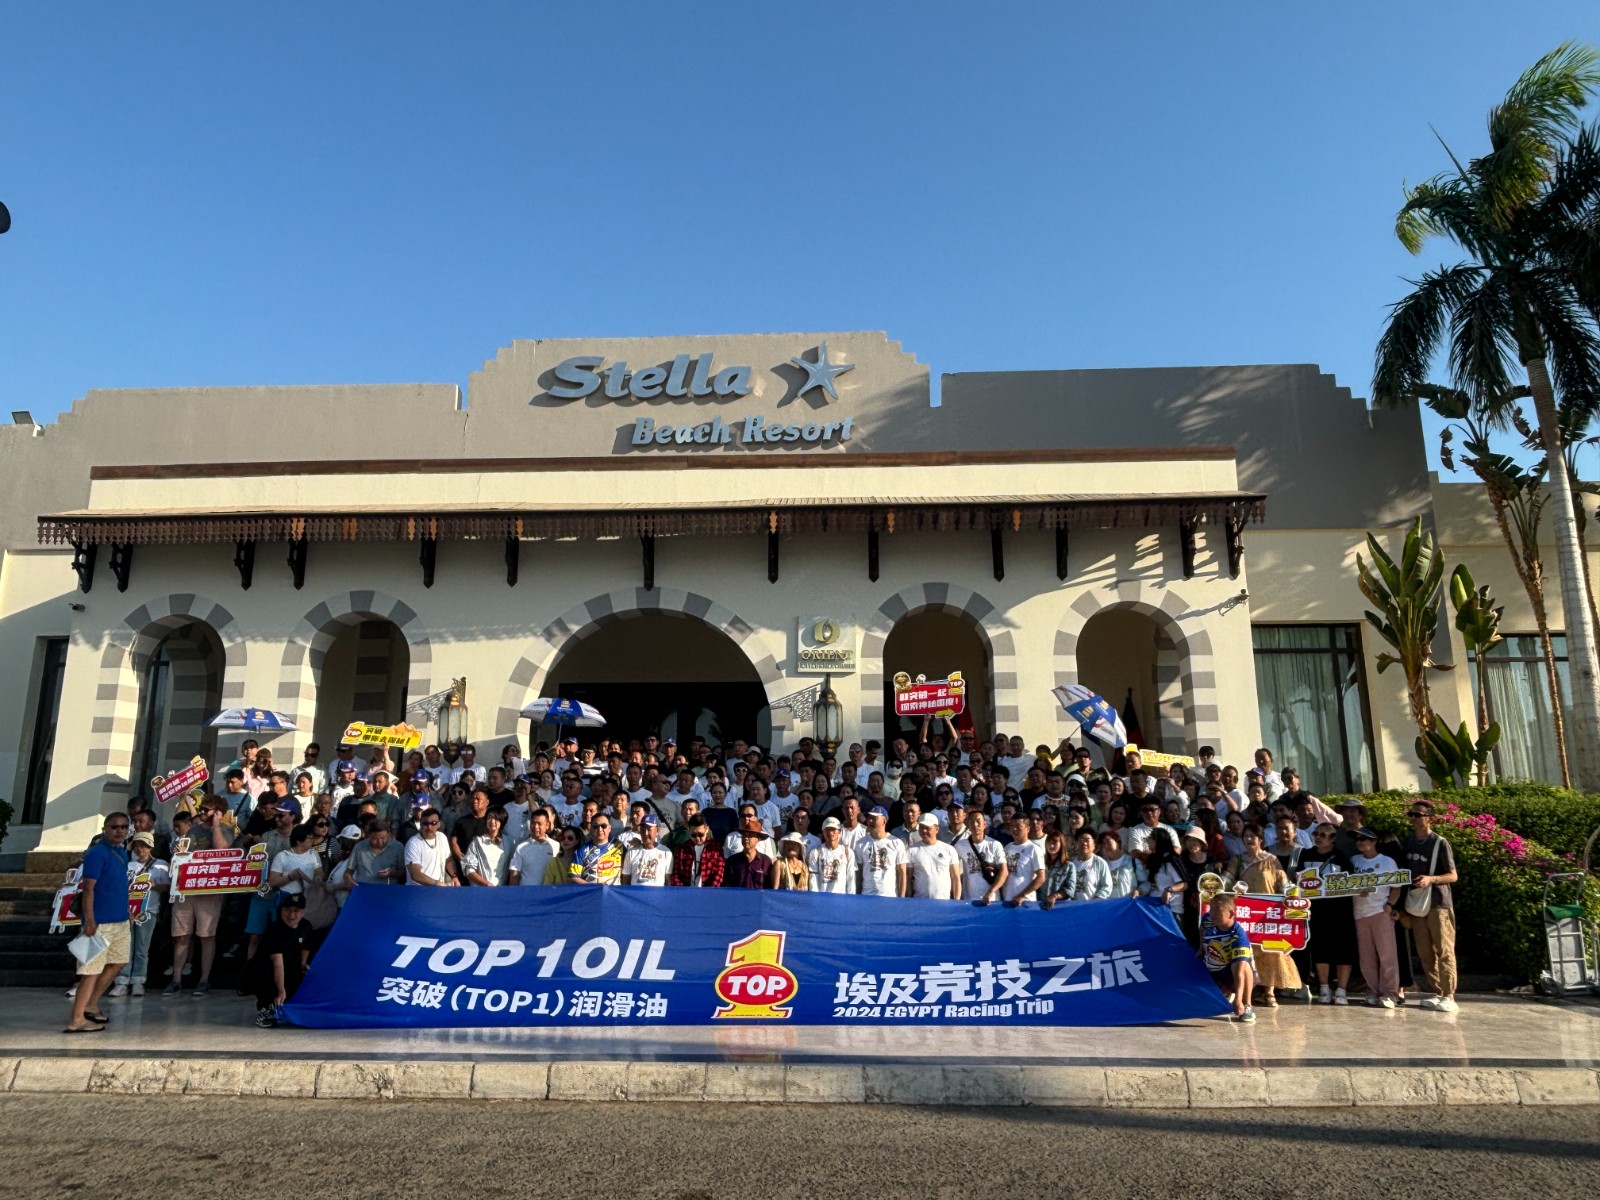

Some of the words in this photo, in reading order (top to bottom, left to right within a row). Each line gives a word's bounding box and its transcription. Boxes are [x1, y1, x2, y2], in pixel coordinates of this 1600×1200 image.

[549, 352, 753, 398] Stella
[631, 416, 731, 445] Beach
[742, 415, 854, 444] Resort
[1301, 880, 1320, 888] TOP
[1286, 899, 1307, 907] TOP
[391, 935, 526, 976] TOP
[536, 938, 567, 978] 1
[571, 936, 677, 980] OIL
[727, 974, 788, 996] TOP
[833, 949, 1150, 1005] 埃及竞技之旅
[832, 1006, 881, 1018] 2024
[884, 1005, 942, 1018] EGYPT
[944, 1003, 1013, 1018] Racing
[1015, 998, 1055, 1015] Trip
